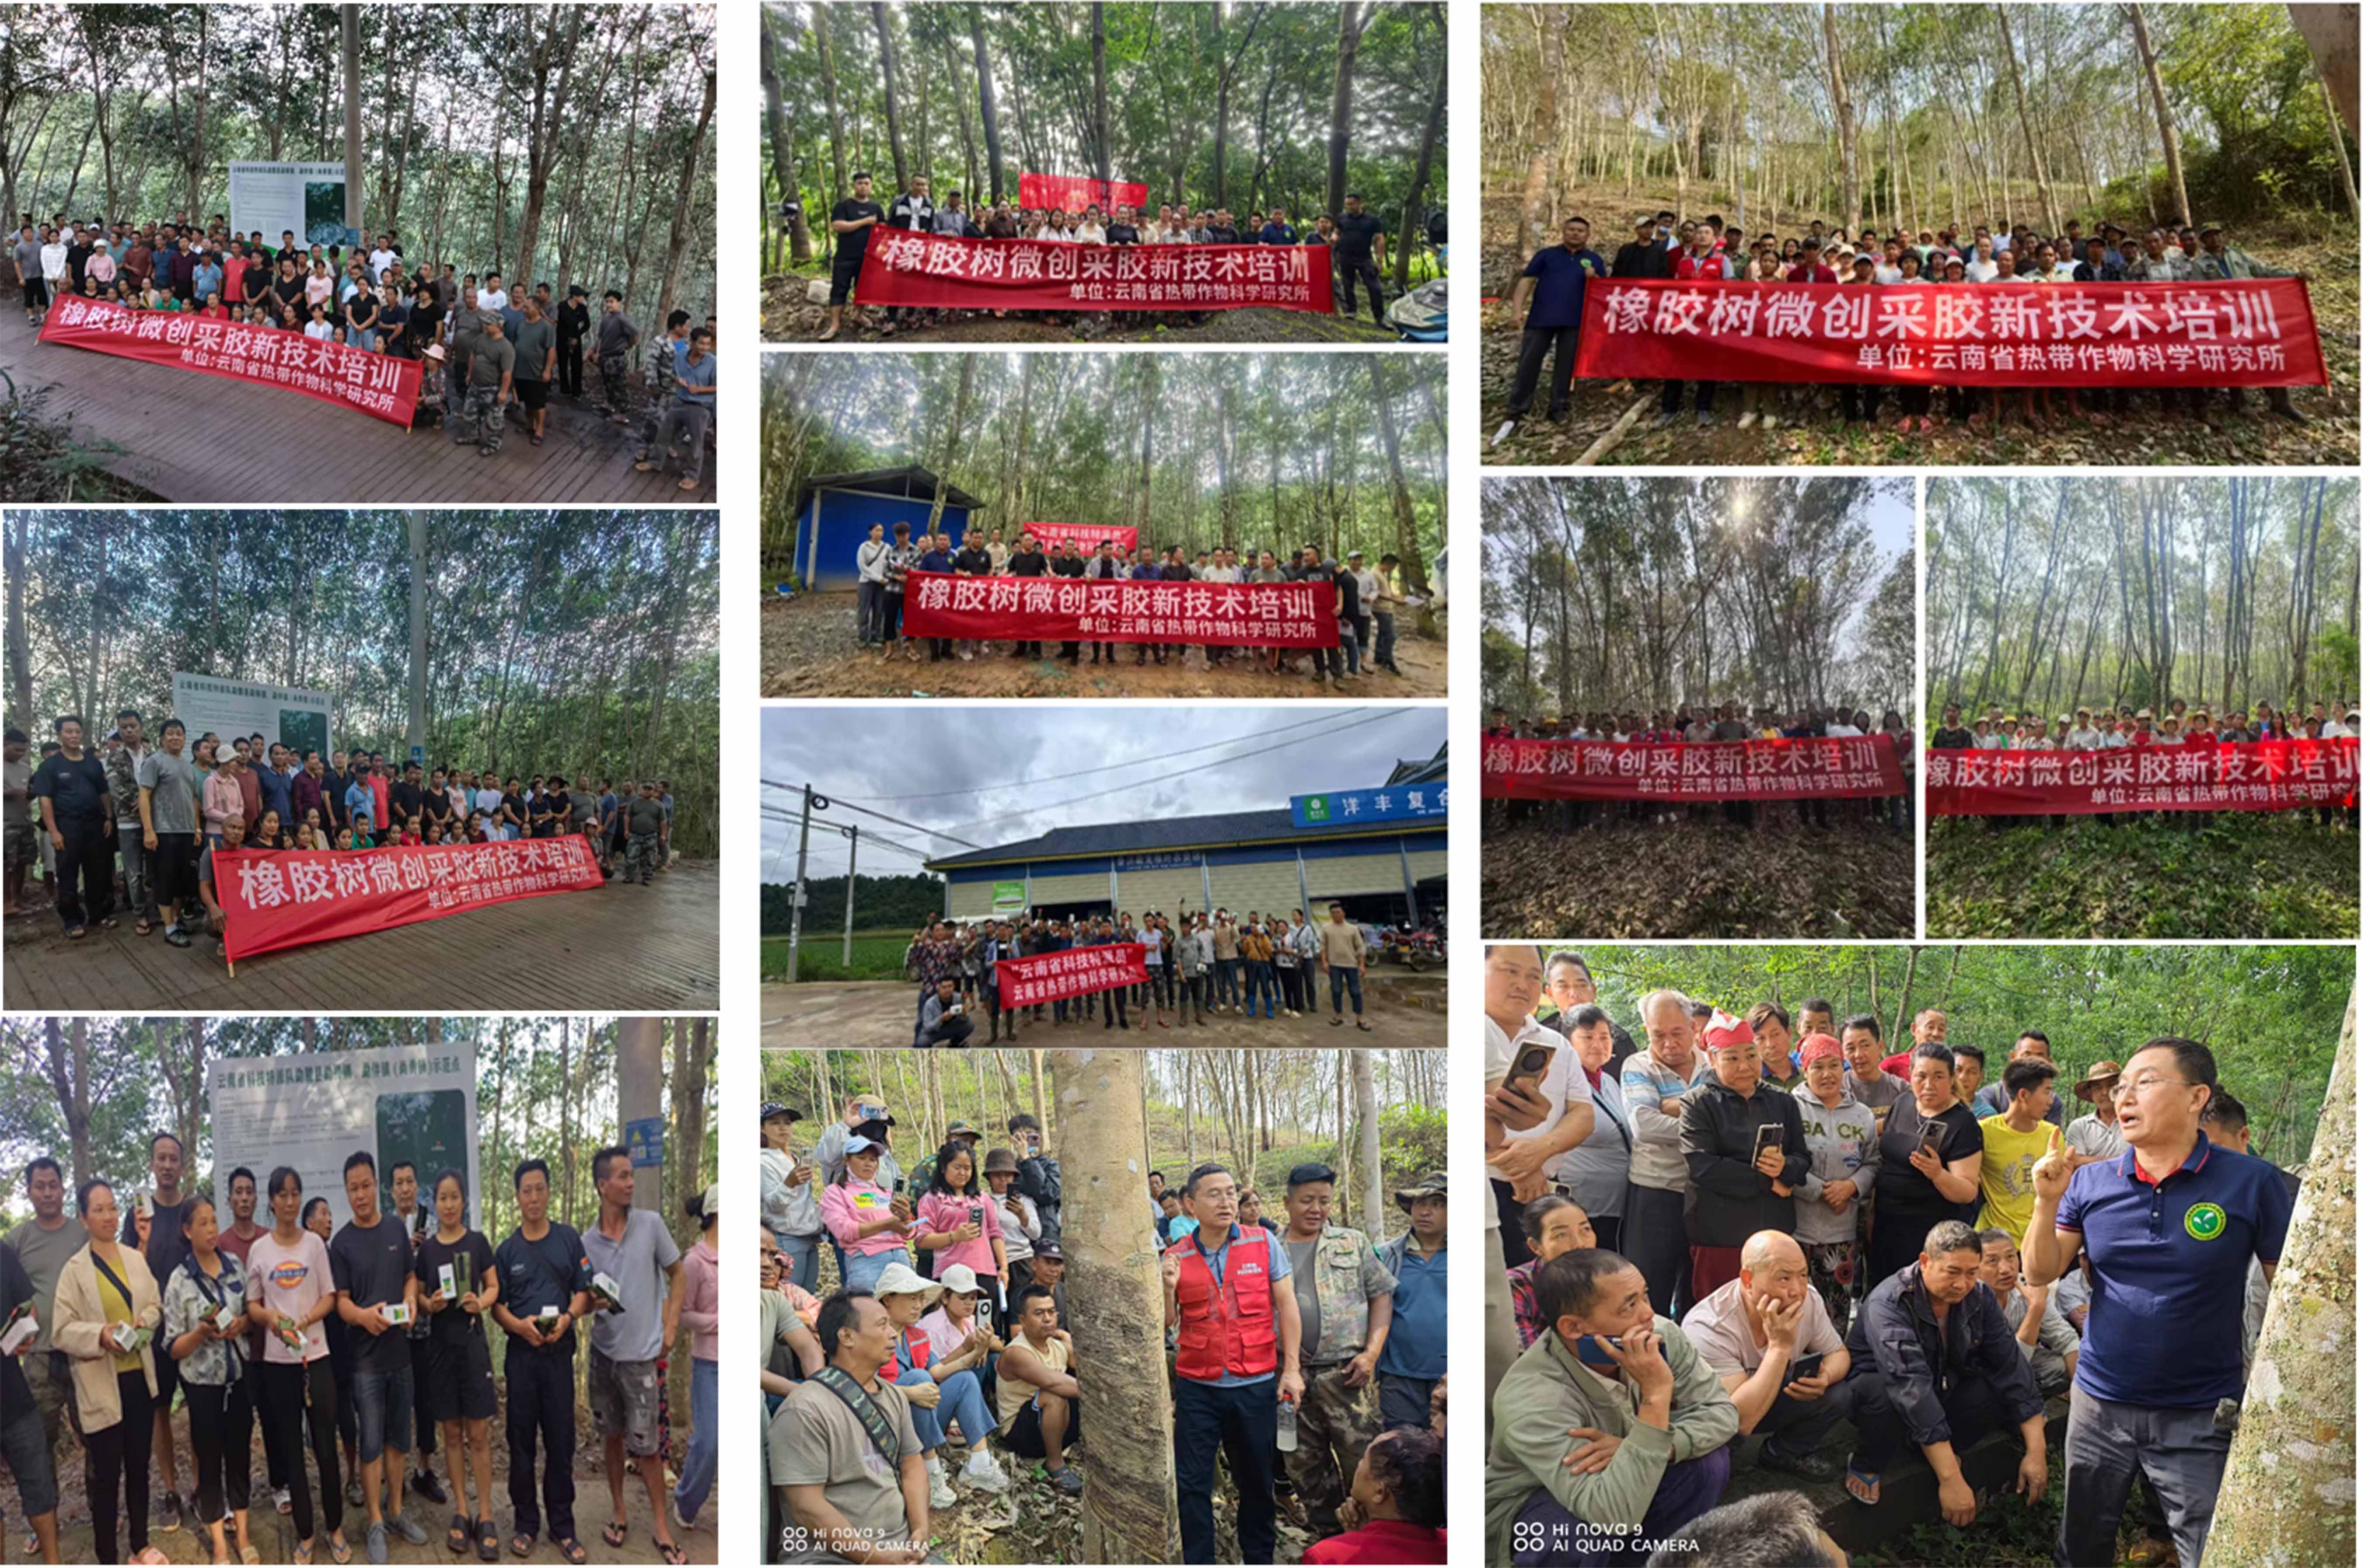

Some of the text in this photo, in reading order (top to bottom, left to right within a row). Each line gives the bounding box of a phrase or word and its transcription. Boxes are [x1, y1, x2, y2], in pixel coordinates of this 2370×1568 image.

[882, 235, 1309, 282] 橡胶树微创采胶新技术培训
[1604, 286, 2280, 340] 橡胶树微创采胶新技术培训
[60, 299, 401, 393] 橡胶树微创采胶新技术培训
[1857, 344, 2285, 372] 单位:云南省热带作物科学研究所
[918, 578, 1315, 620] 橡胶树微创采胶新技术培训
[1485, 741, 1878, 776] 橡胶树微创采胶新技术培训
[1926, 746, 2360, 787] 橡胶树微创采胶新技术培训
[2091, 783, 2360, 804] 单位:云南省热带作物科学研究
[238, 839, 585, 910] 橡胶树微创采胶新技术培训
